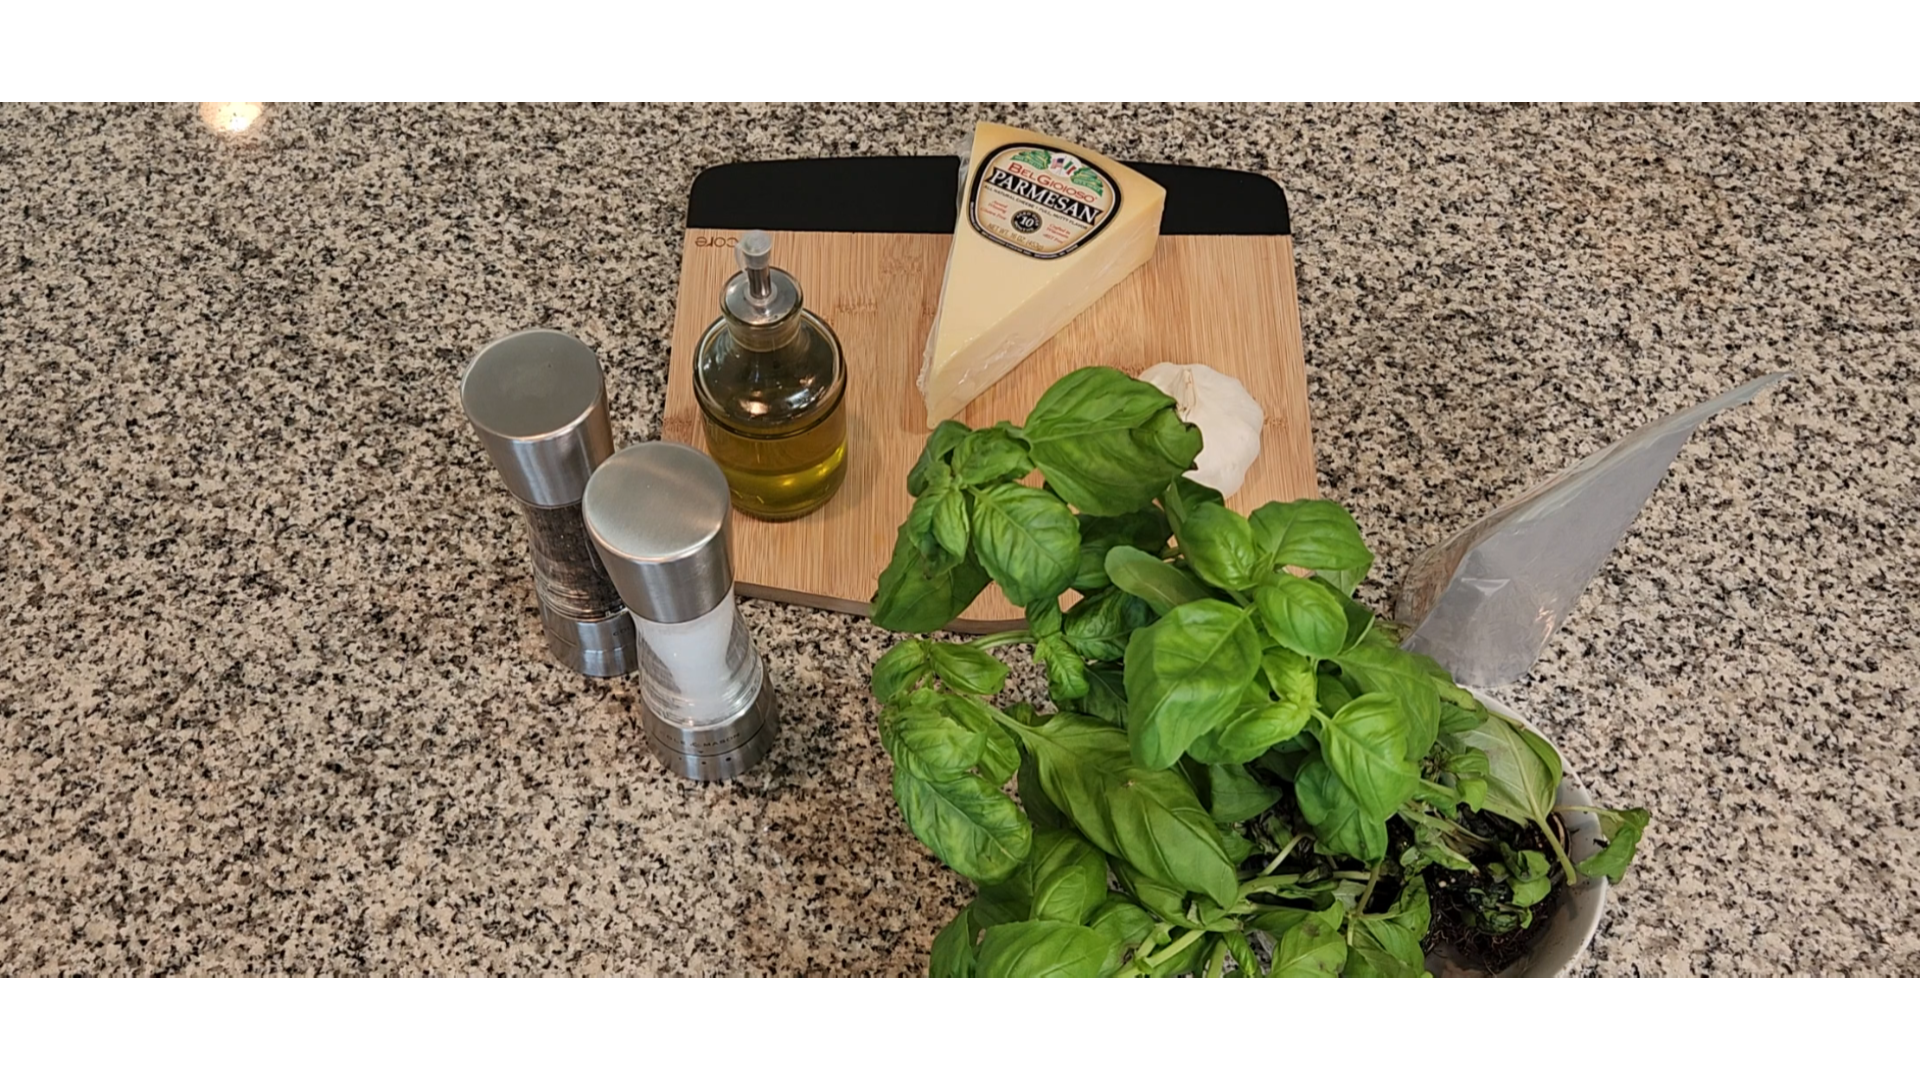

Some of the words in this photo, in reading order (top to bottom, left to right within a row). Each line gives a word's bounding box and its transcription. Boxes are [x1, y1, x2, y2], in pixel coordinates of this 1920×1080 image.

[989, 169, 1099, 223] PARMESAN
[1019, 215, 1035, 227] 10
[695, 236, 739, 248] core
[703, 732, 741, 747] MASON
